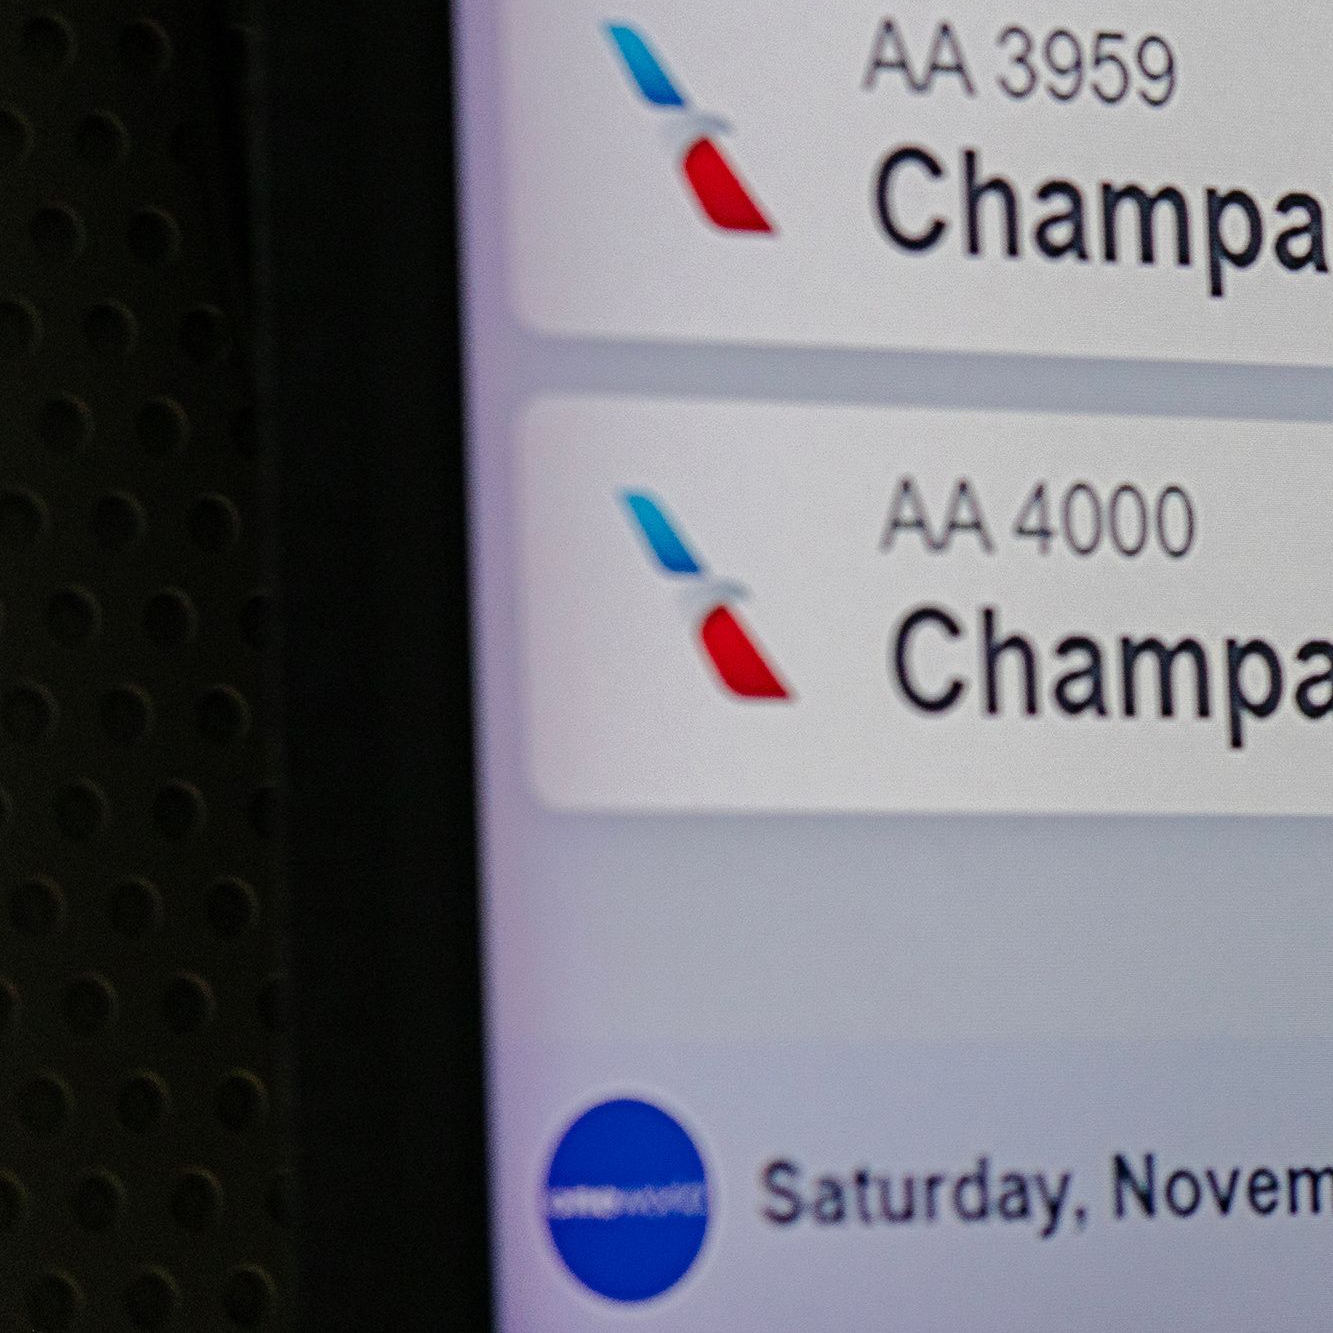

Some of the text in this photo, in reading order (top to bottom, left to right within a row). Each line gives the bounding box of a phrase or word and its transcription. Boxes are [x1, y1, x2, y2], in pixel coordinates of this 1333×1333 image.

[864, 17, 1178, 110] AA 3959
[882, 477, 1197, 561] AA 4000
[762, 1156, 1088, 1240] Saturday,
